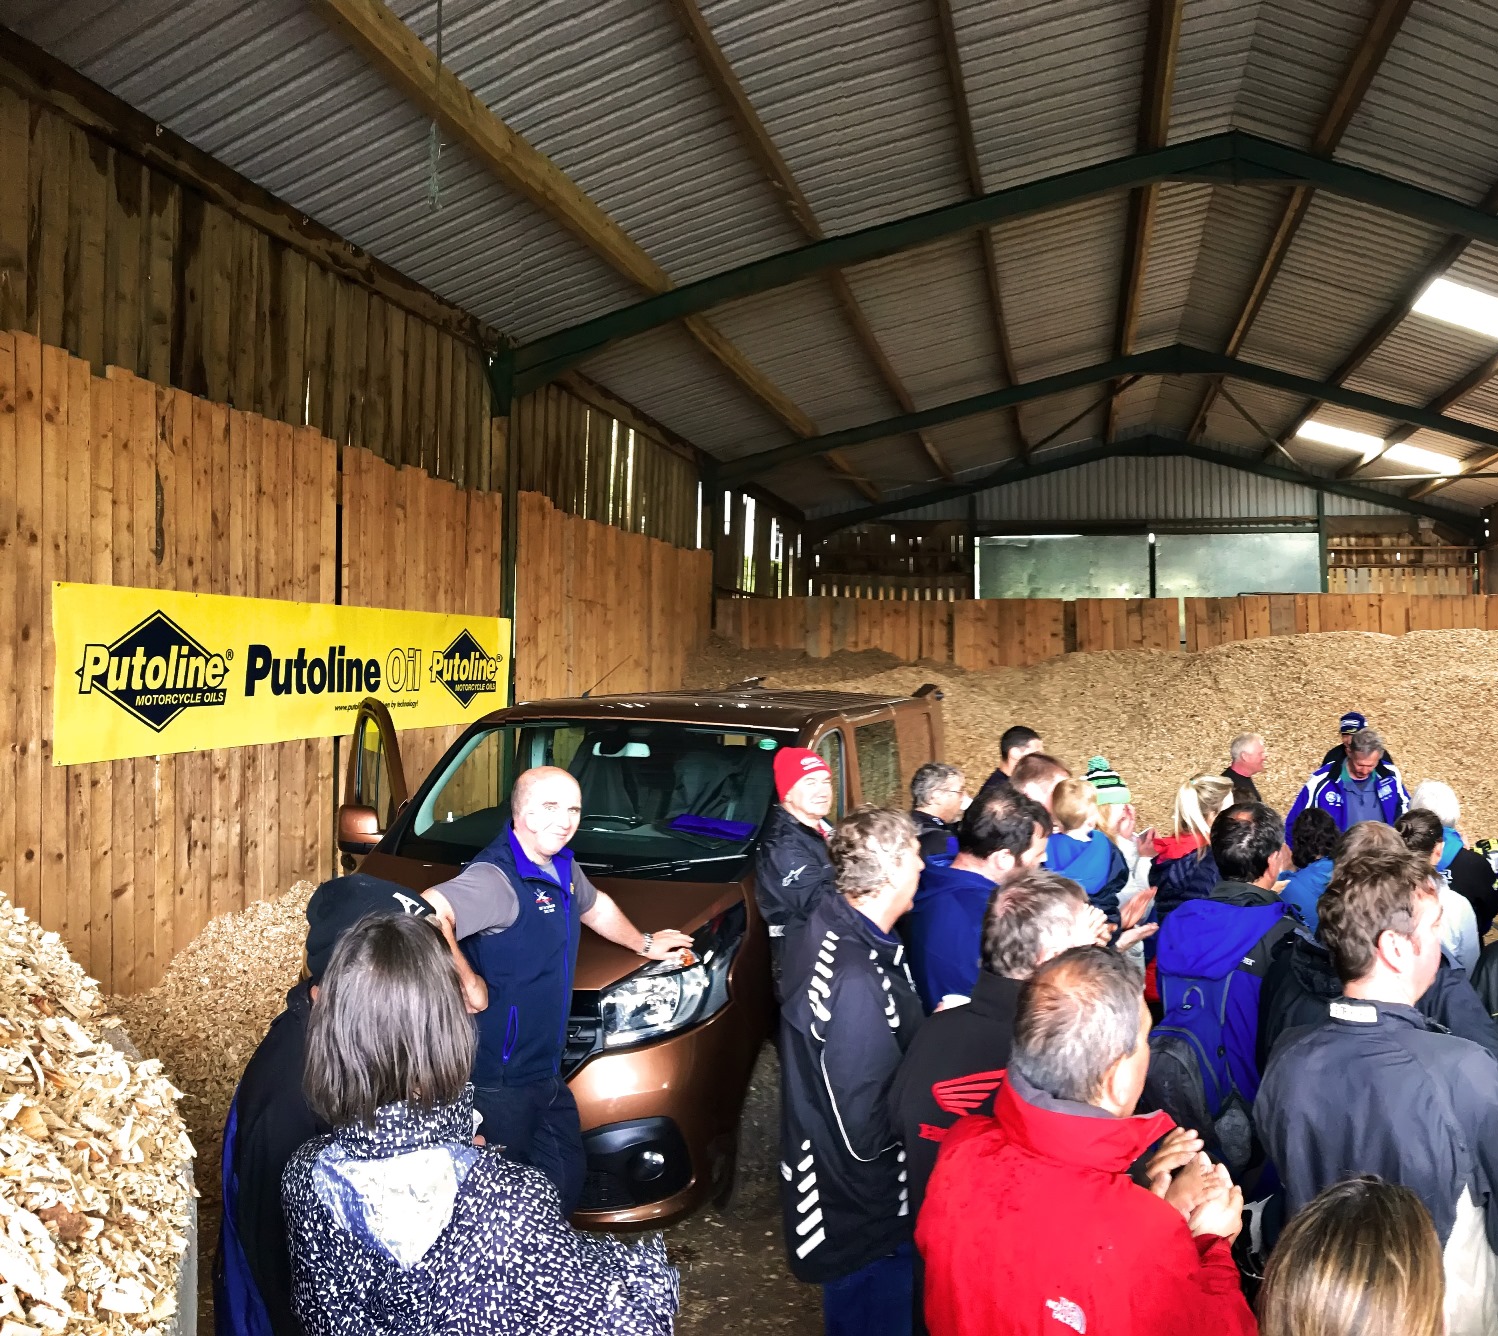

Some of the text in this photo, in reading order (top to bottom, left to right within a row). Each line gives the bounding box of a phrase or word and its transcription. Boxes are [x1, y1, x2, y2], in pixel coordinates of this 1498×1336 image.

[79, 643, 226, 694] Putoline
[245, 644, 422, 696] Putoline Oil
[430, 650, 498, 682] Putoline
[135, 692, 225, 707] MOTORCYCLE OILS
[455, 681, 497, 693] MOTORCYCLE OILS
